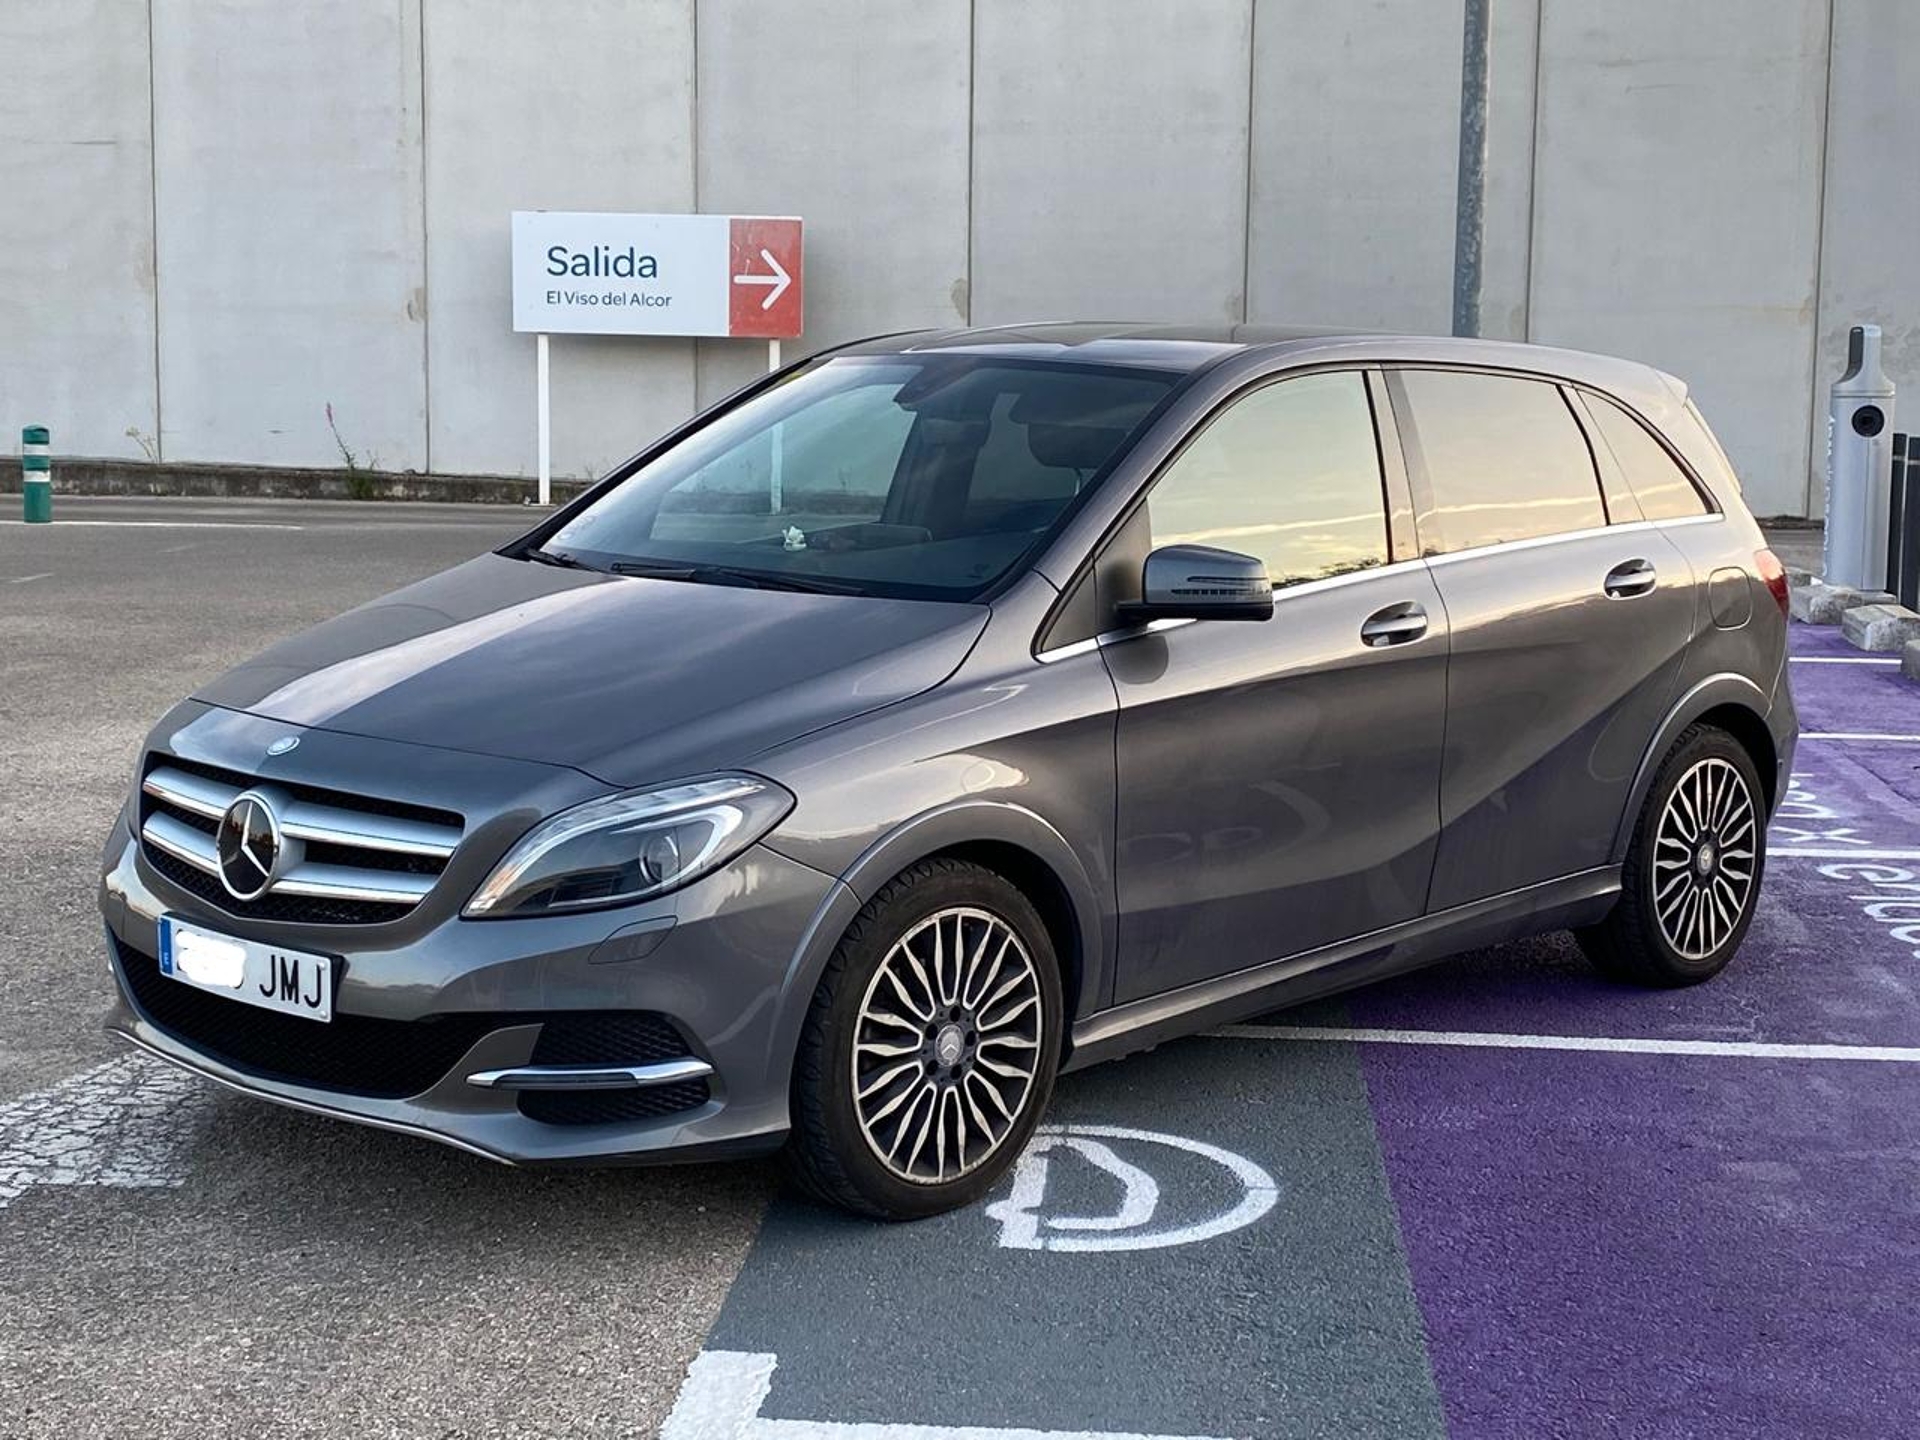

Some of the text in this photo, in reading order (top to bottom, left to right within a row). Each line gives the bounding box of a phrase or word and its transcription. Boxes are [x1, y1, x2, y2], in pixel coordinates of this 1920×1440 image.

[547, 245, 658, 279] Salida
[546, 290, 672, 308] El Viso del Alcor
[259, 953, 323, 1009] JMJ
